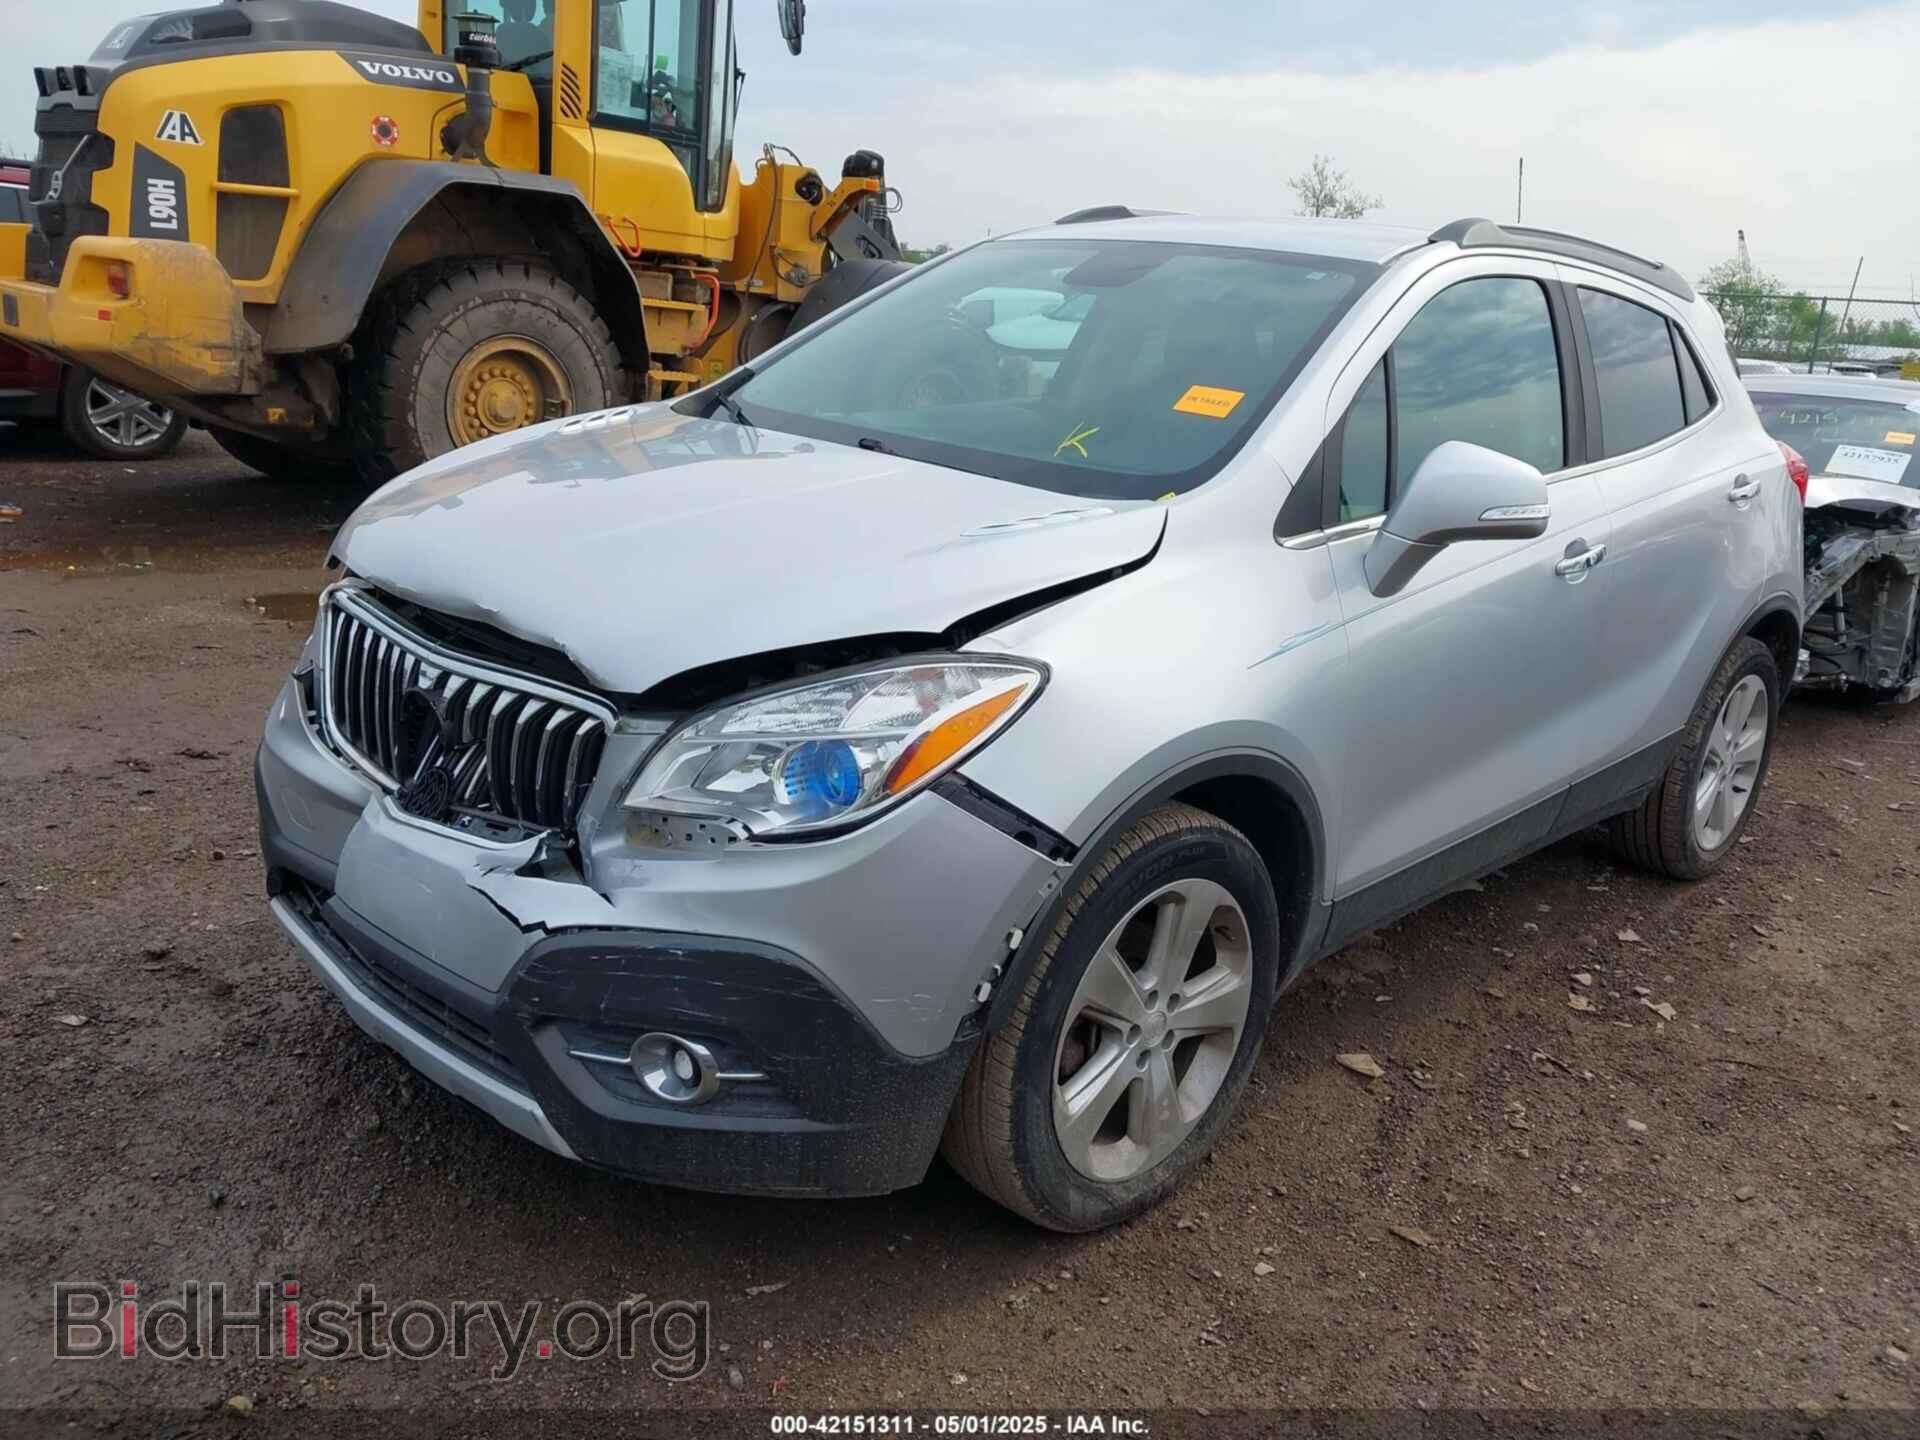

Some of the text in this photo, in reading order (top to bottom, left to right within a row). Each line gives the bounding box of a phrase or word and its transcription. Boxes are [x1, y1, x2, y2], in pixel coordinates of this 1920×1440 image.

[357, 60, 455, 84] VOLVO
[147, 178, 178, 230] L90H
[1053, 421, 1101, 459] K
